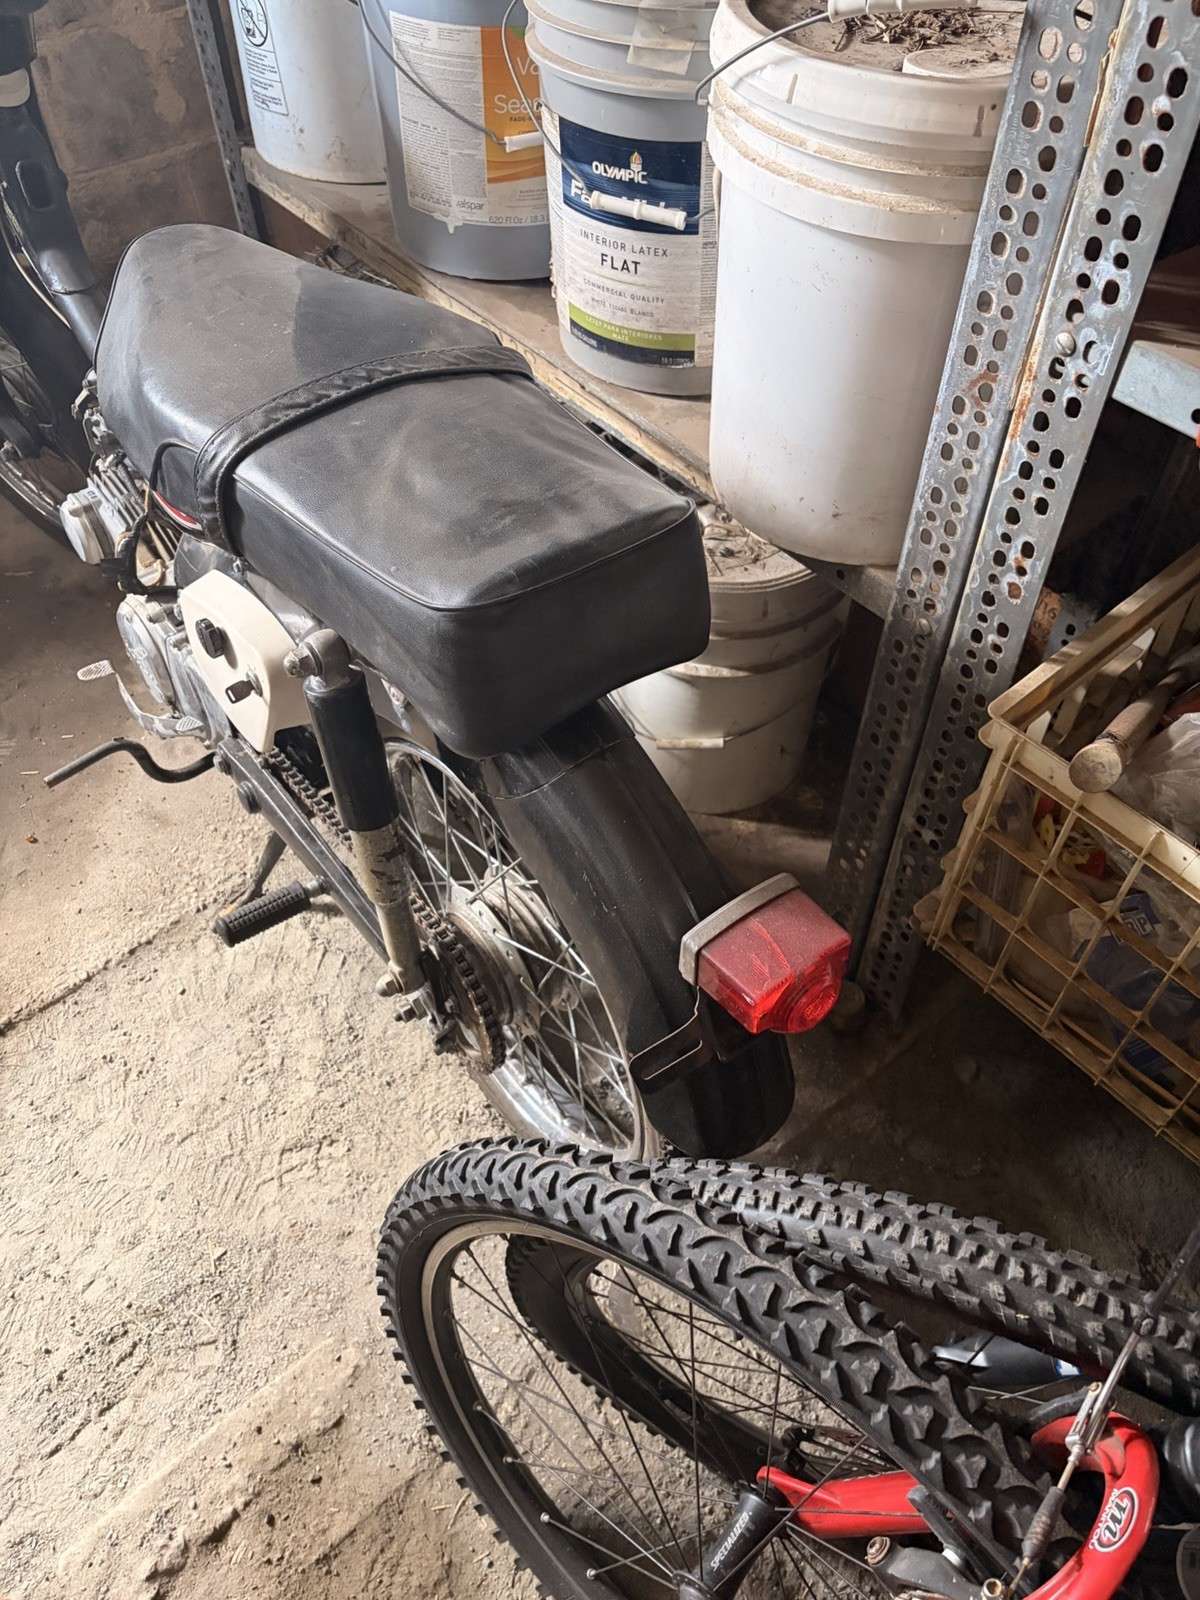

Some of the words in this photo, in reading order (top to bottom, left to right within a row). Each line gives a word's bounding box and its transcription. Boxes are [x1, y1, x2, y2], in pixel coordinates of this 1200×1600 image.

[591, 160, 648, 185] OLYMPIC
[580, 228, 627, 252] INTERIOR
[631, 244, 668, 258] LATEX
[600, 252, 641, 275] FLAT
[583, 278, 628, 299] COMMERCIAL
[630, 293, 665, 305] QUALITY
[710, 1510, 751, 1572] SPECIALIZED
